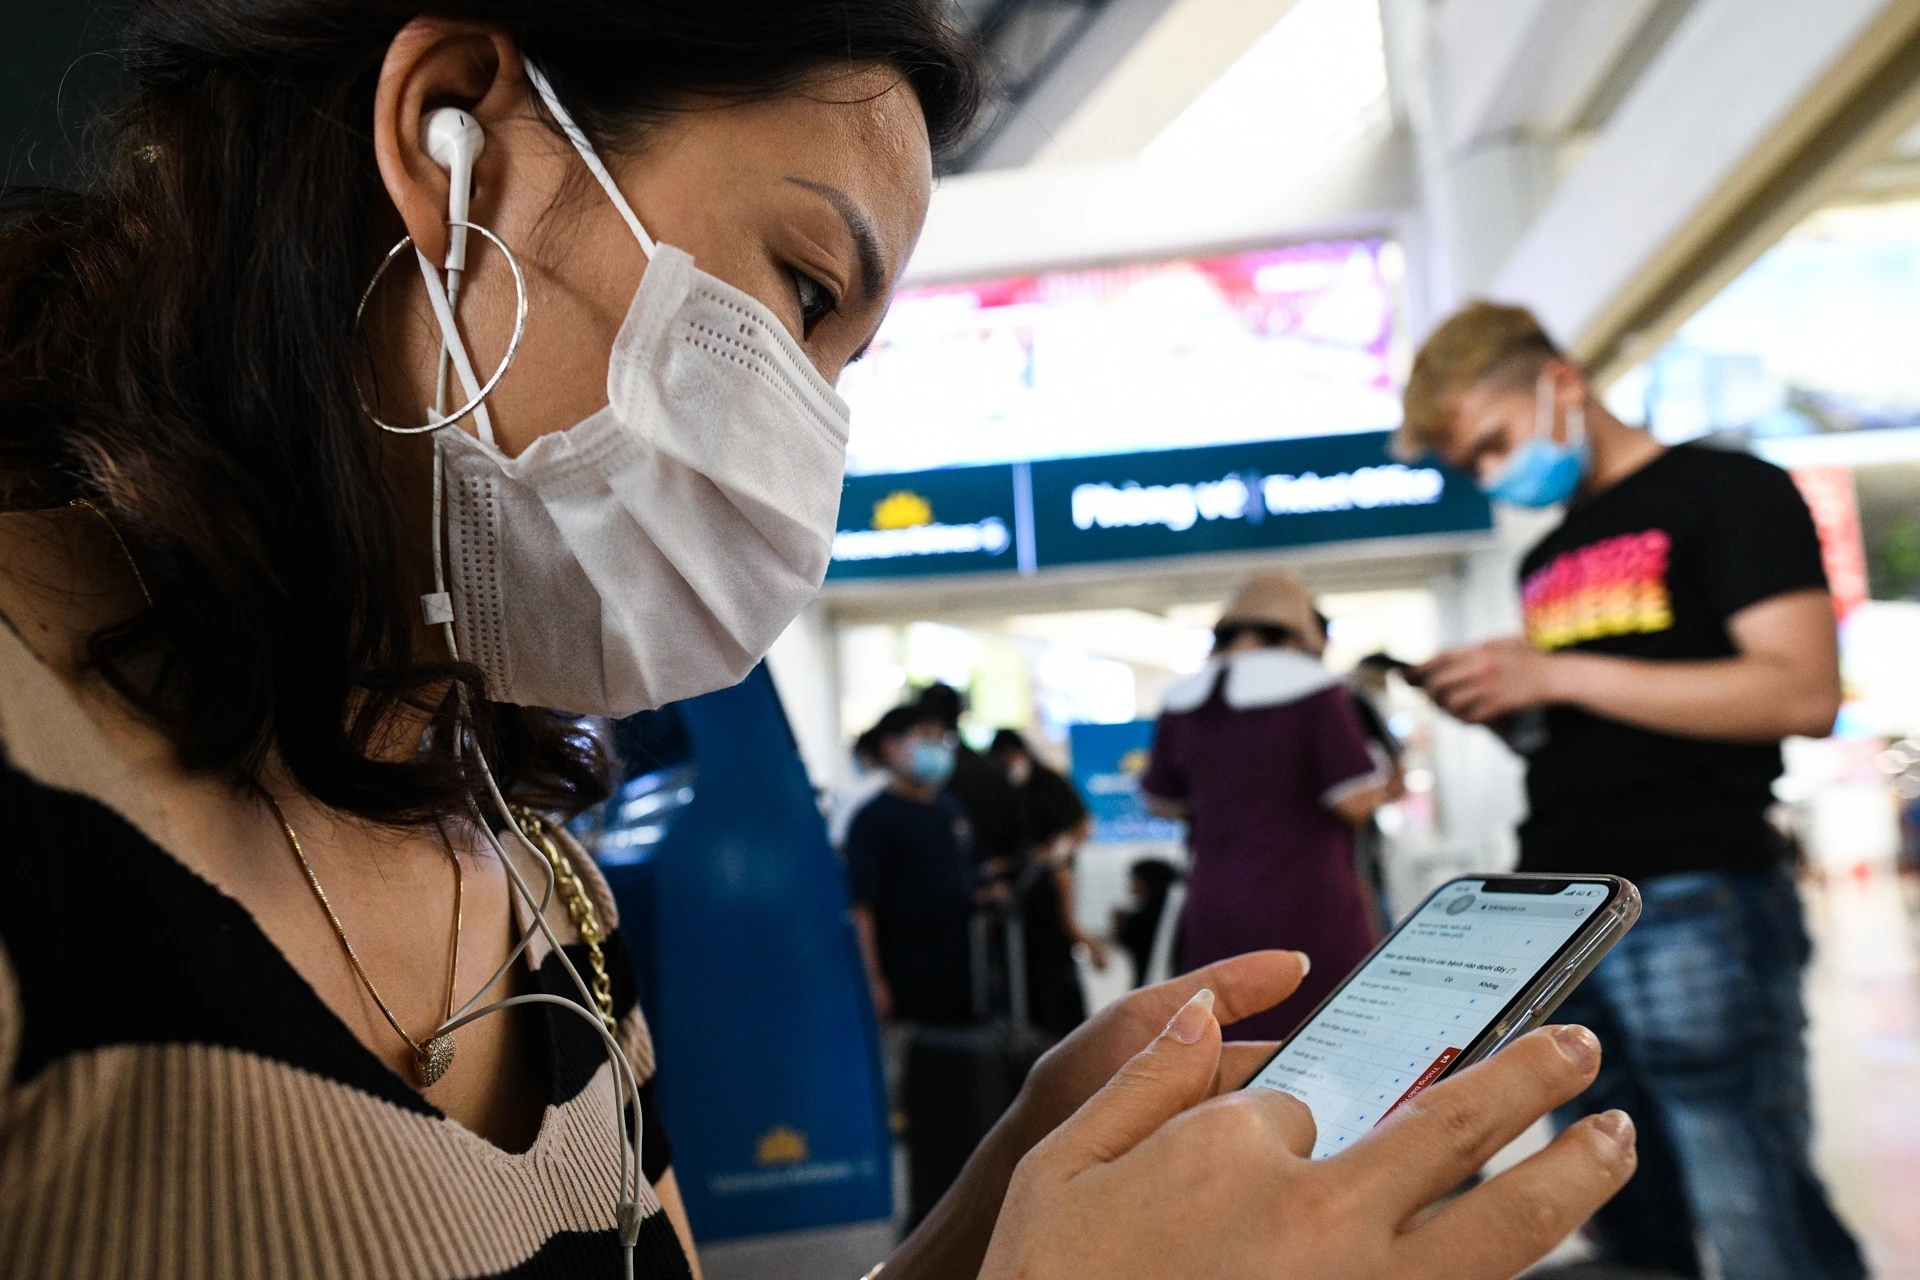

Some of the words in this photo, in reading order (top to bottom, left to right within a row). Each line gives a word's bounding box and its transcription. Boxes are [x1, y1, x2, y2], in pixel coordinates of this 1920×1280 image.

[1493, 964, 1508, 973] đây
[1478, 980, 1500, 990] Không
[1418, 1066, 1441, 1086] Thông
[1407, 1086, 1422, 1098] báo
